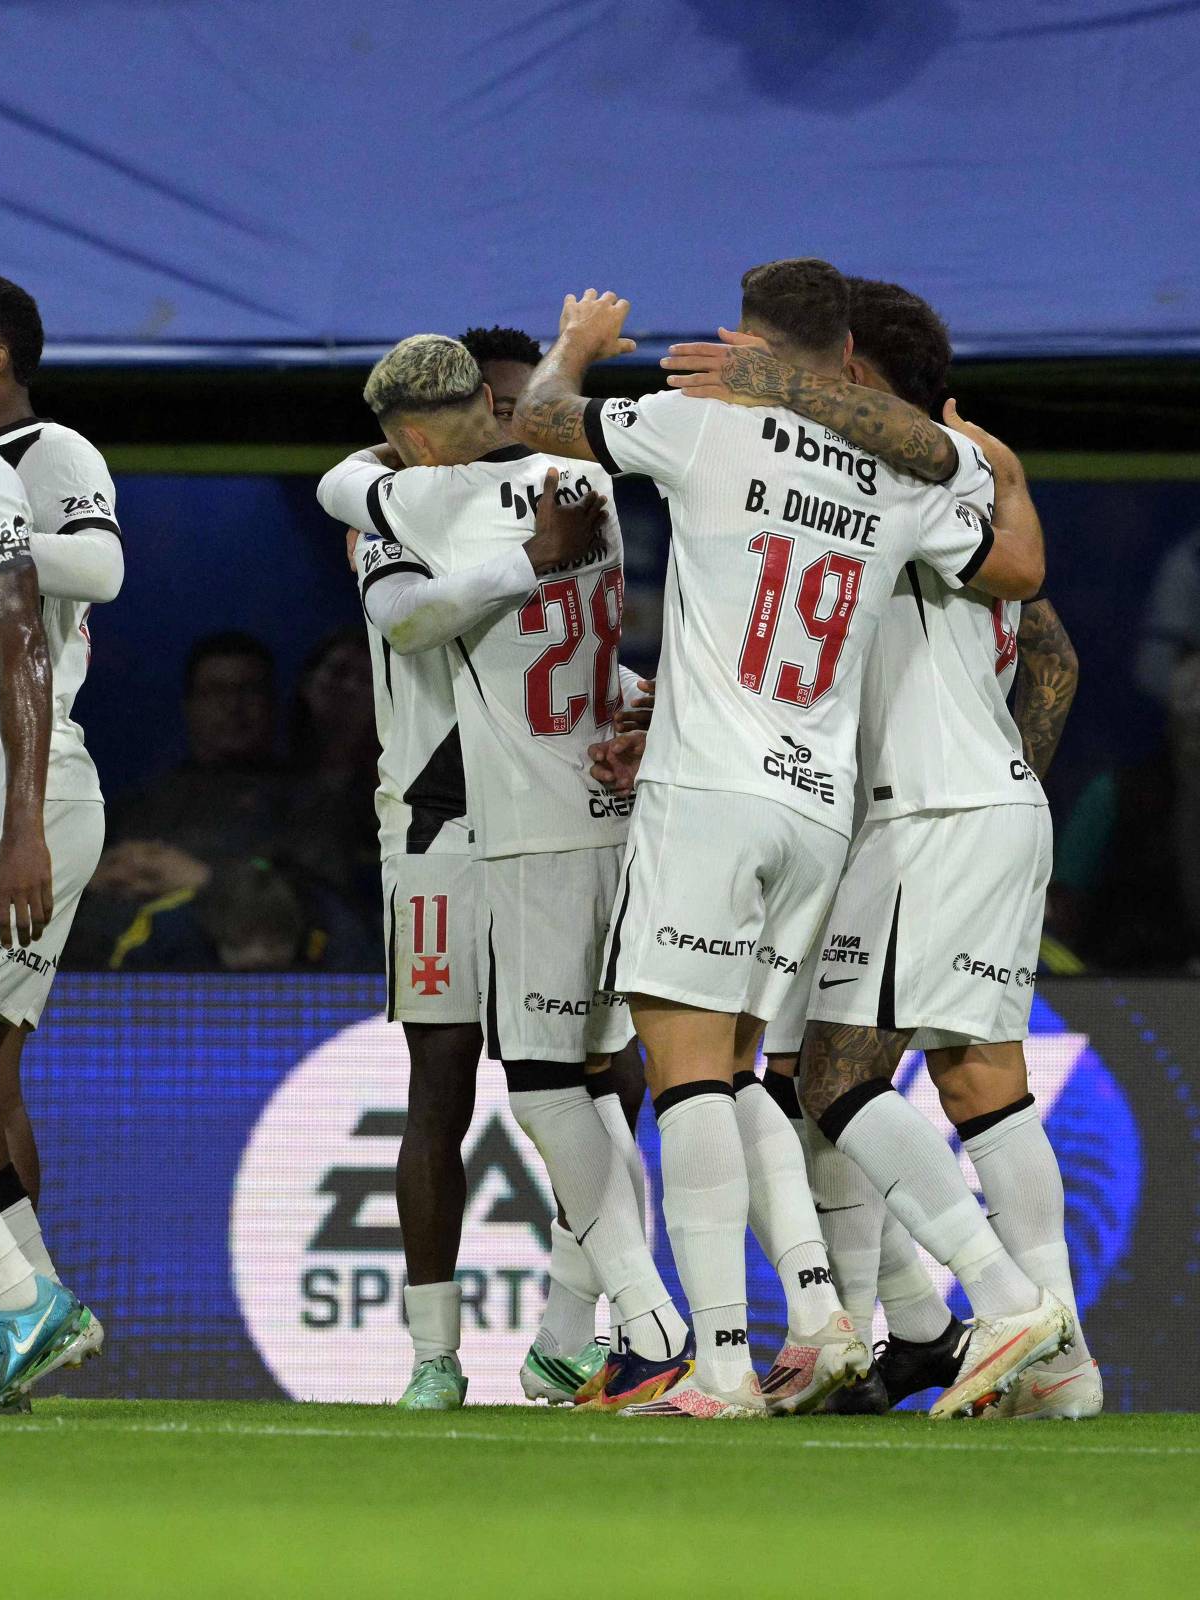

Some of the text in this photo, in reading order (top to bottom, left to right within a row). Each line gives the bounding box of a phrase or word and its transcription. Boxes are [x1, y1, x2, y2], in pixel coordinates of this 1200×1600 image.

[795, 425, 877, 496] bmg
[60, 496, 93, 514] Zé
[745, 479, 881, 547] B. DUARTE
[567, 589, 577, 620] SCORE
[761, 589, 775, 620] SCORE
[845, 569, 856, 601] SCORE
[737, 531, 866, 709] 19
[518, 564, 624, 736] 28
[409, 895, 448, 954] 11
[678, 934, 757, 956] FACILITY
[830, 934, 861, 949] VIVA
[821, 949, 870, 965] SORTE
[305, 1110, 558, 1252] EA
[300, 1268, 550, 1328] SPRT
